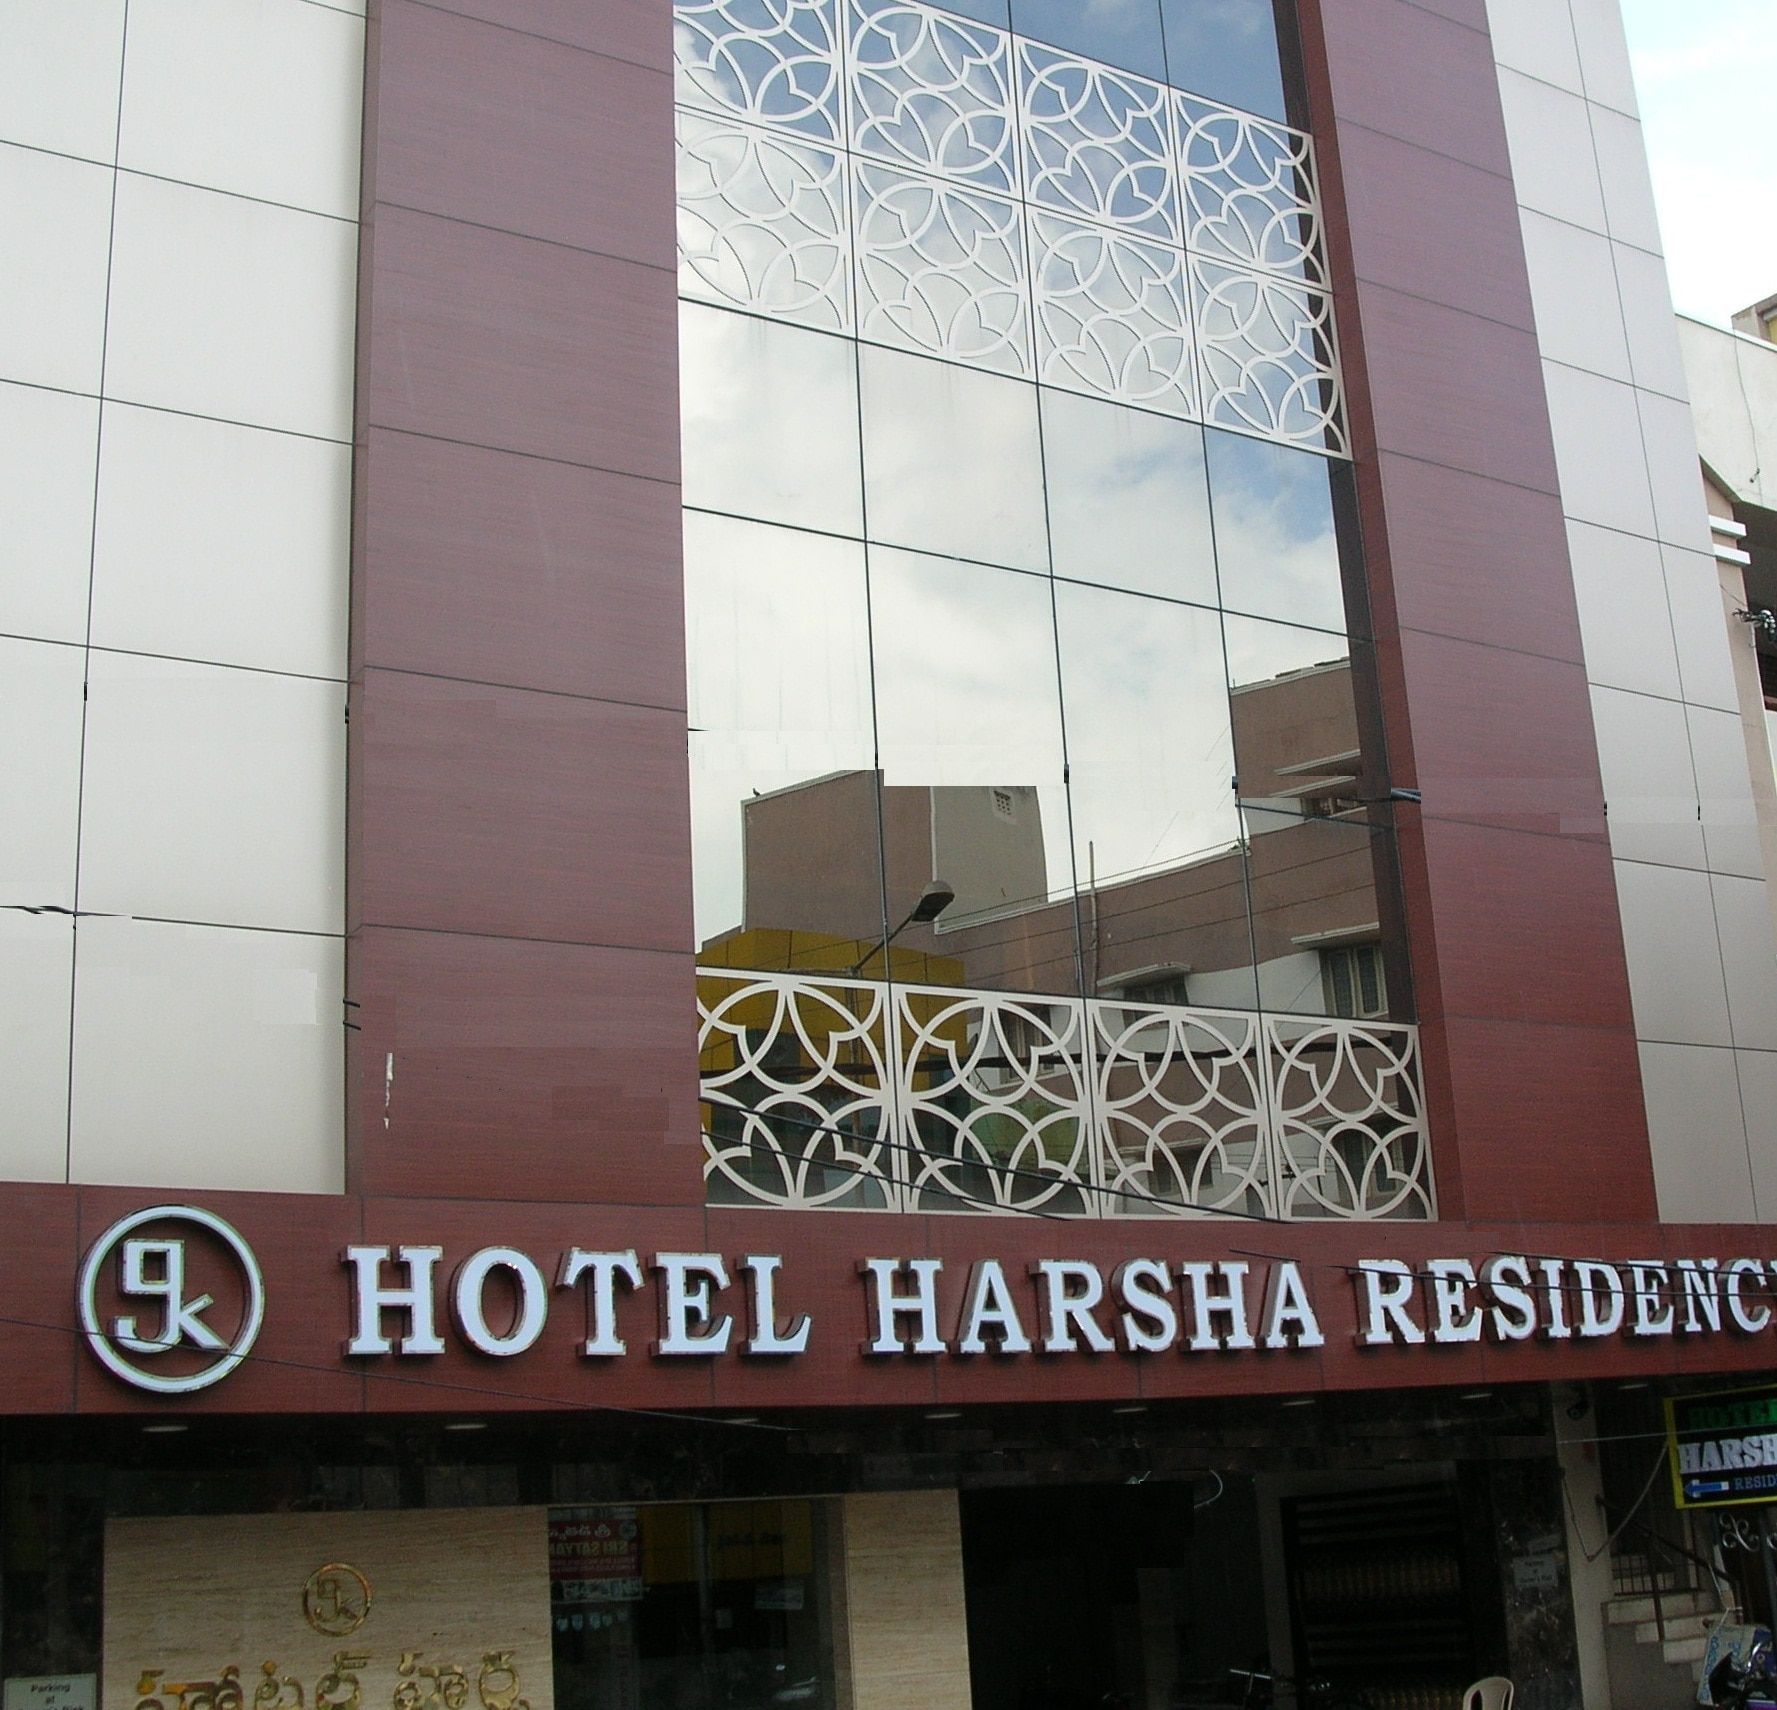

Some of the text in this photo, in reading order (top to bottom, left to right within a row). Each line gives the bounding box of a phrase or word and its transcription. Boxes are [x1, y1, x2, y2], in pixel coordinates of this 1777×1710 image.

[342, 1244, 1777, 1357] HOTEL HARSHA RESIDENC
